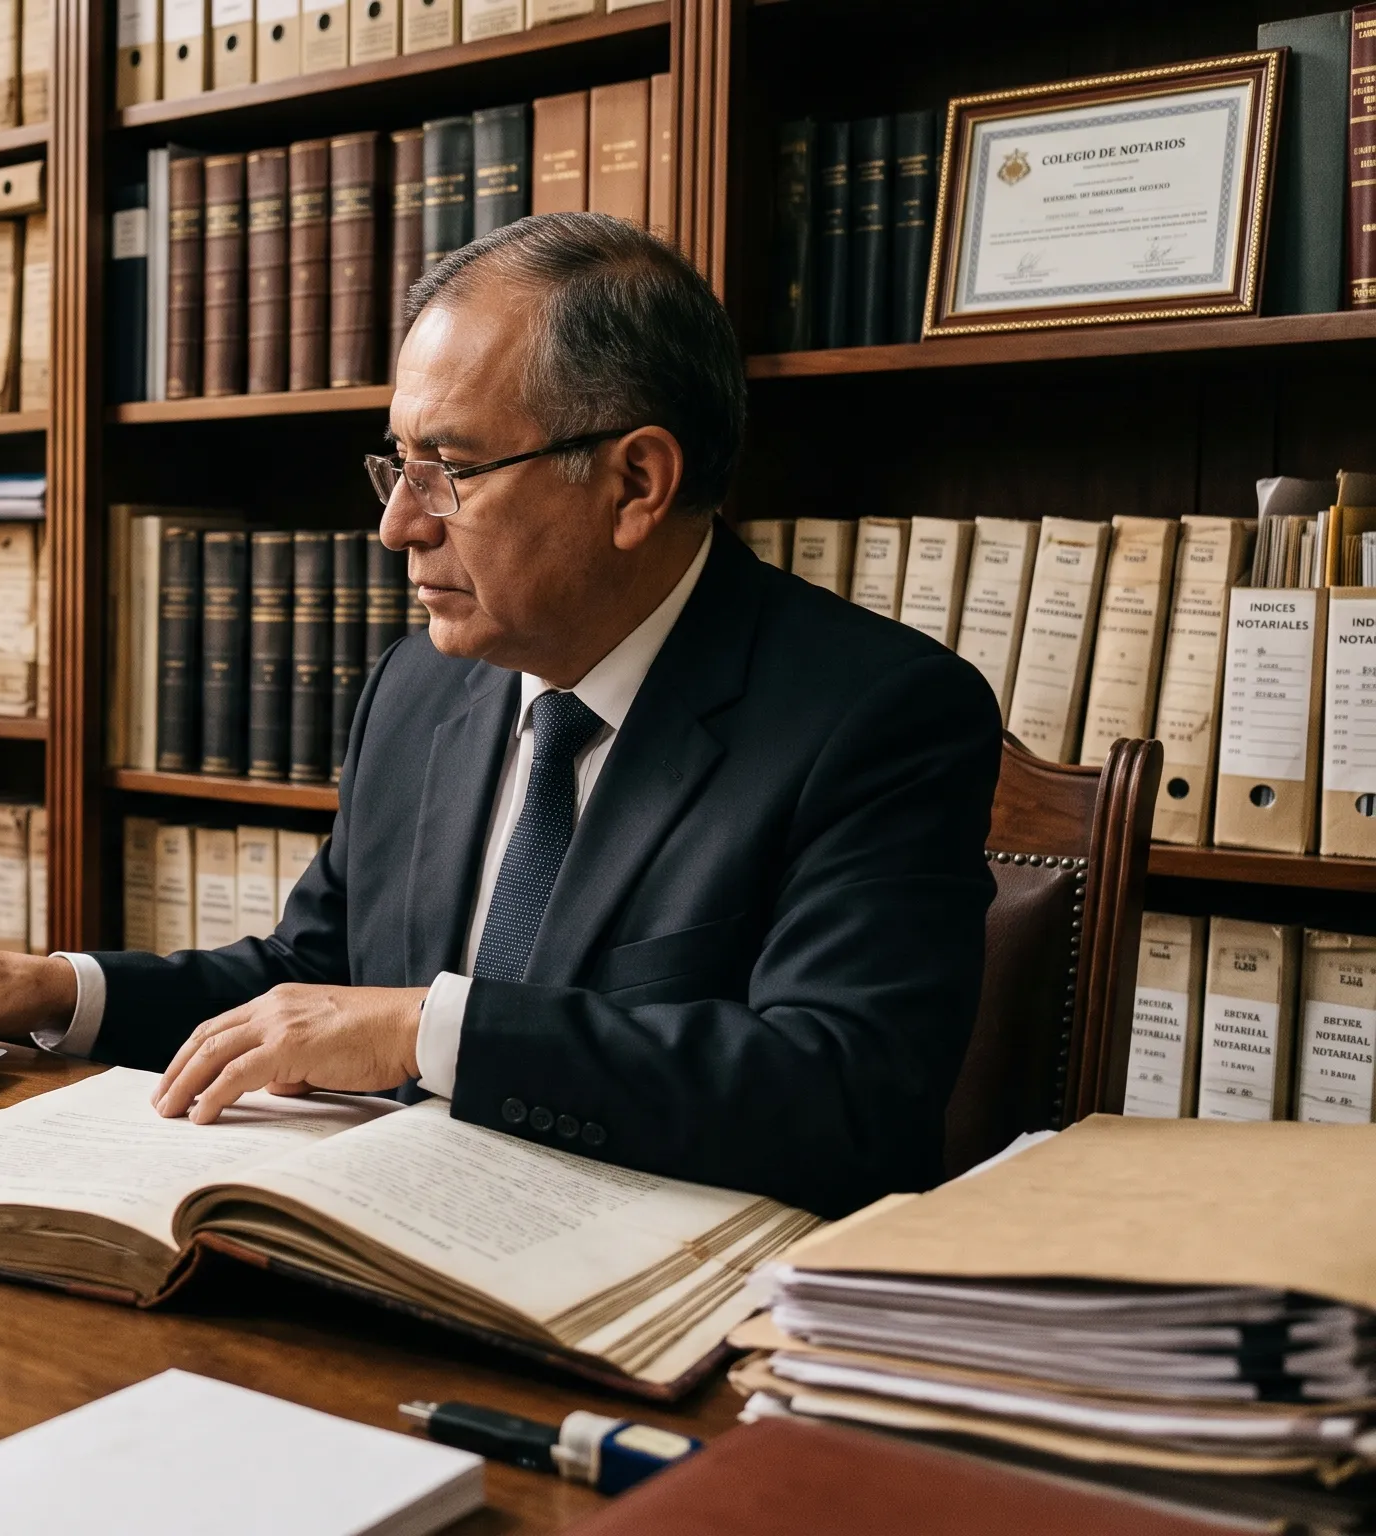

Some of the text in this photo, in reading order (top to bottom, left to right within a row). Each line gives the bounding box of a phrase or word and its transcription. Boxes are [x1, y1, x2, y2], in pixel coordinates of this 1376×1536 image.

[1042, 149, 1096, 166] COLEGIO
[1099, 146, 1116, 159] DE
[1120, 137, 1186, 157] NOTARIOS
[1250, 603, 1296, 613] INDICES
[1236, 619, 1309, 631] NOTARIALES
[1339, 634, 1376, 645] NOTA
